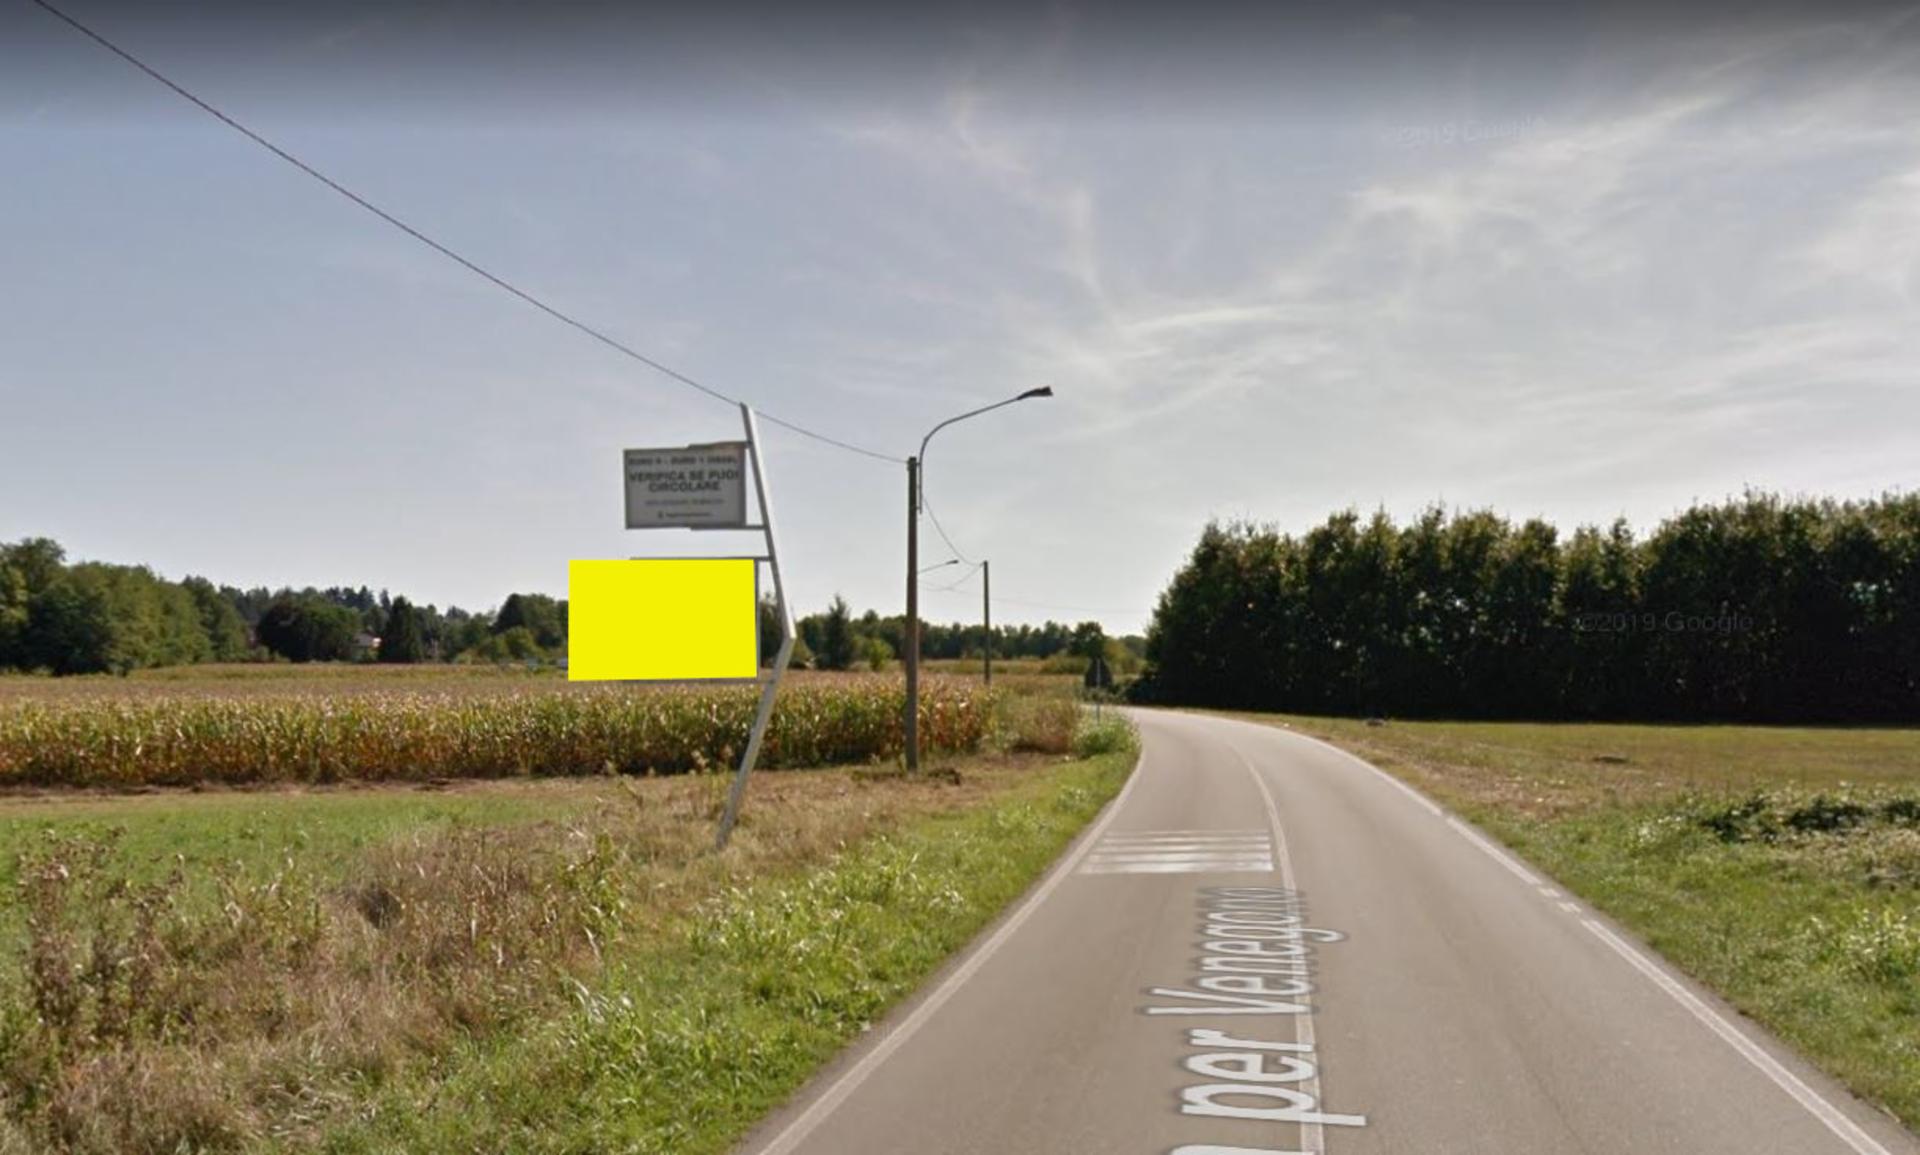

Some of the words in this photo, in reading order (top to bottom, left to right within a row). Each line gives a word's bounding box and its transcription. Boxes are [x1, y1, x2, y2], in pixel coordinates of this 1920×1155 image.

[629, 470, 686, 481] VERIFICA
[689, 470, 704, 480] SE
[708, 468, 739, 480] PUOI
[649, 481, 720, 492] CIRCOLARE
[1146, 886, 1346, 1016] Venegono
[1181, 1029, 1367, 1126] per
